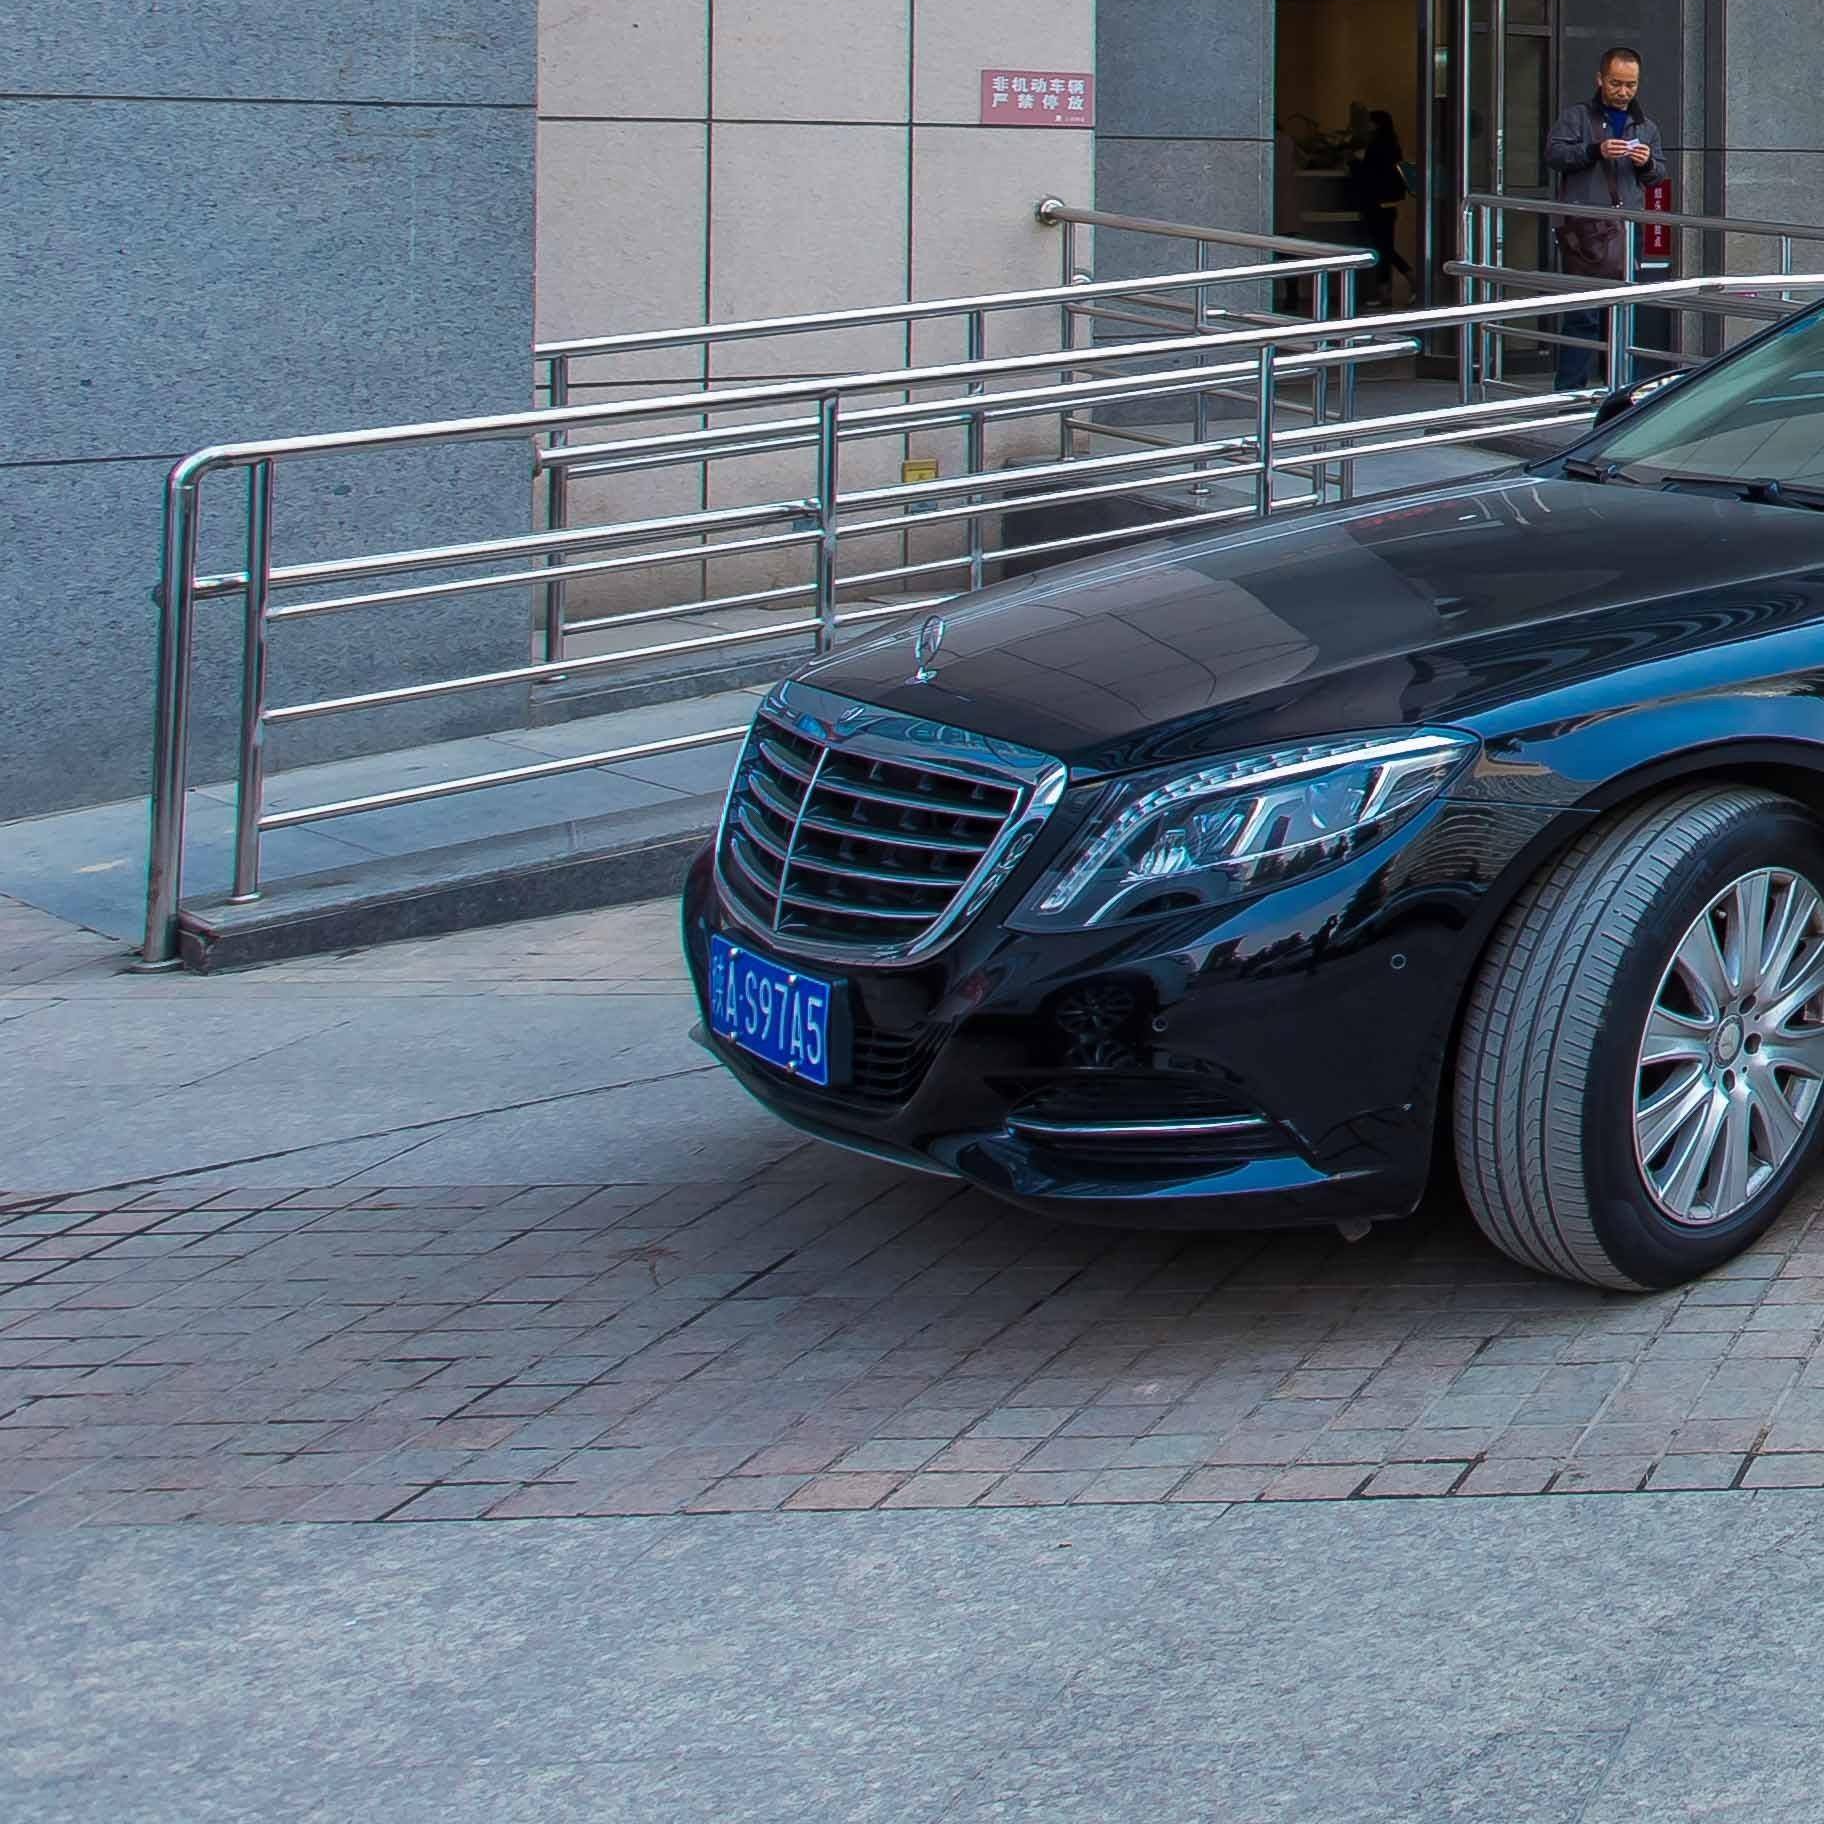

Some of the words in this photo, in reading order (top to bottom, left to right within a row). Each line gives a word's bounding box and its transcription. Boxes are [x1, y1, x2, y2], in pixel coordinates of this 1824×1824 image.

[992, 76, 1085, 94] 非机动车辆
[991, 93, 1085, 110] 严禁停放
